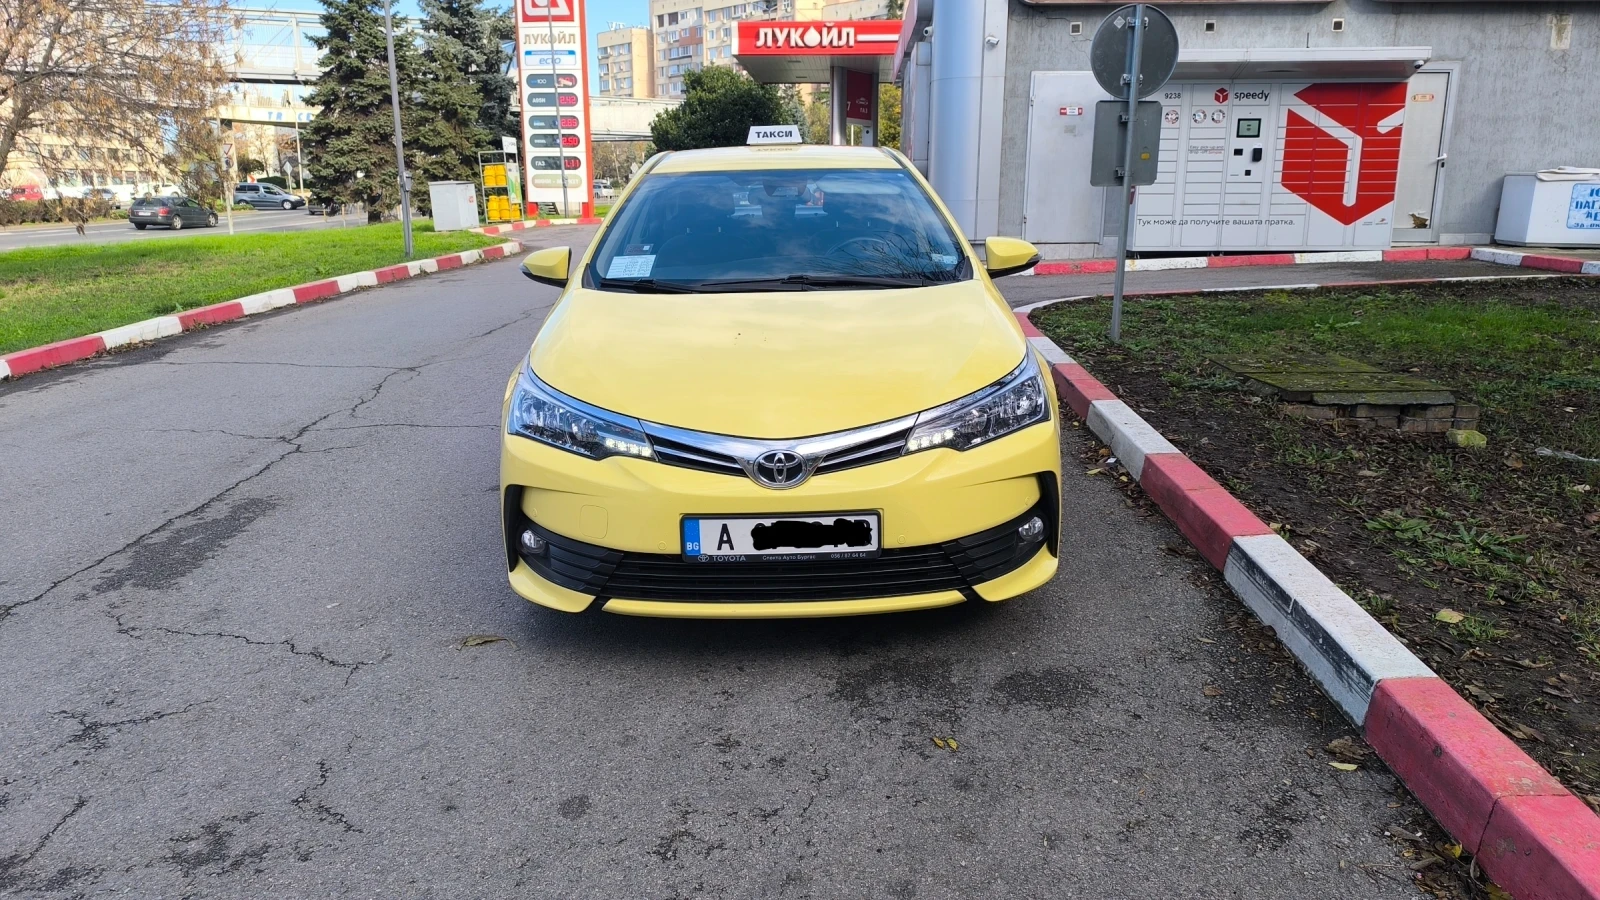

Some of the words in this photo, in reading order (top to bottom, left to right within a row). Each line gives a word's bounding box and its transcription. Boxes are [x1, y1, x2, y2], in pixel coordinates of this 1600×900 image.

[523, 31, 576, 45] ЛУКОЙЛ
[755, 22, 855, 48] ЛУКОЙЛ
[1164, 92, 1181, 100] 9238
[1234, 90, 1269, 101] speedy
[755, 130, 793, 139] ТАКСИ
[1137, 218, 1152, 226] Тук
[1190, 218, 1230, 227] получите
[1264, 218, 1296, 227] пратка.
[717, 523, 735, 551] A
[686, 541, 699, 551] BG
